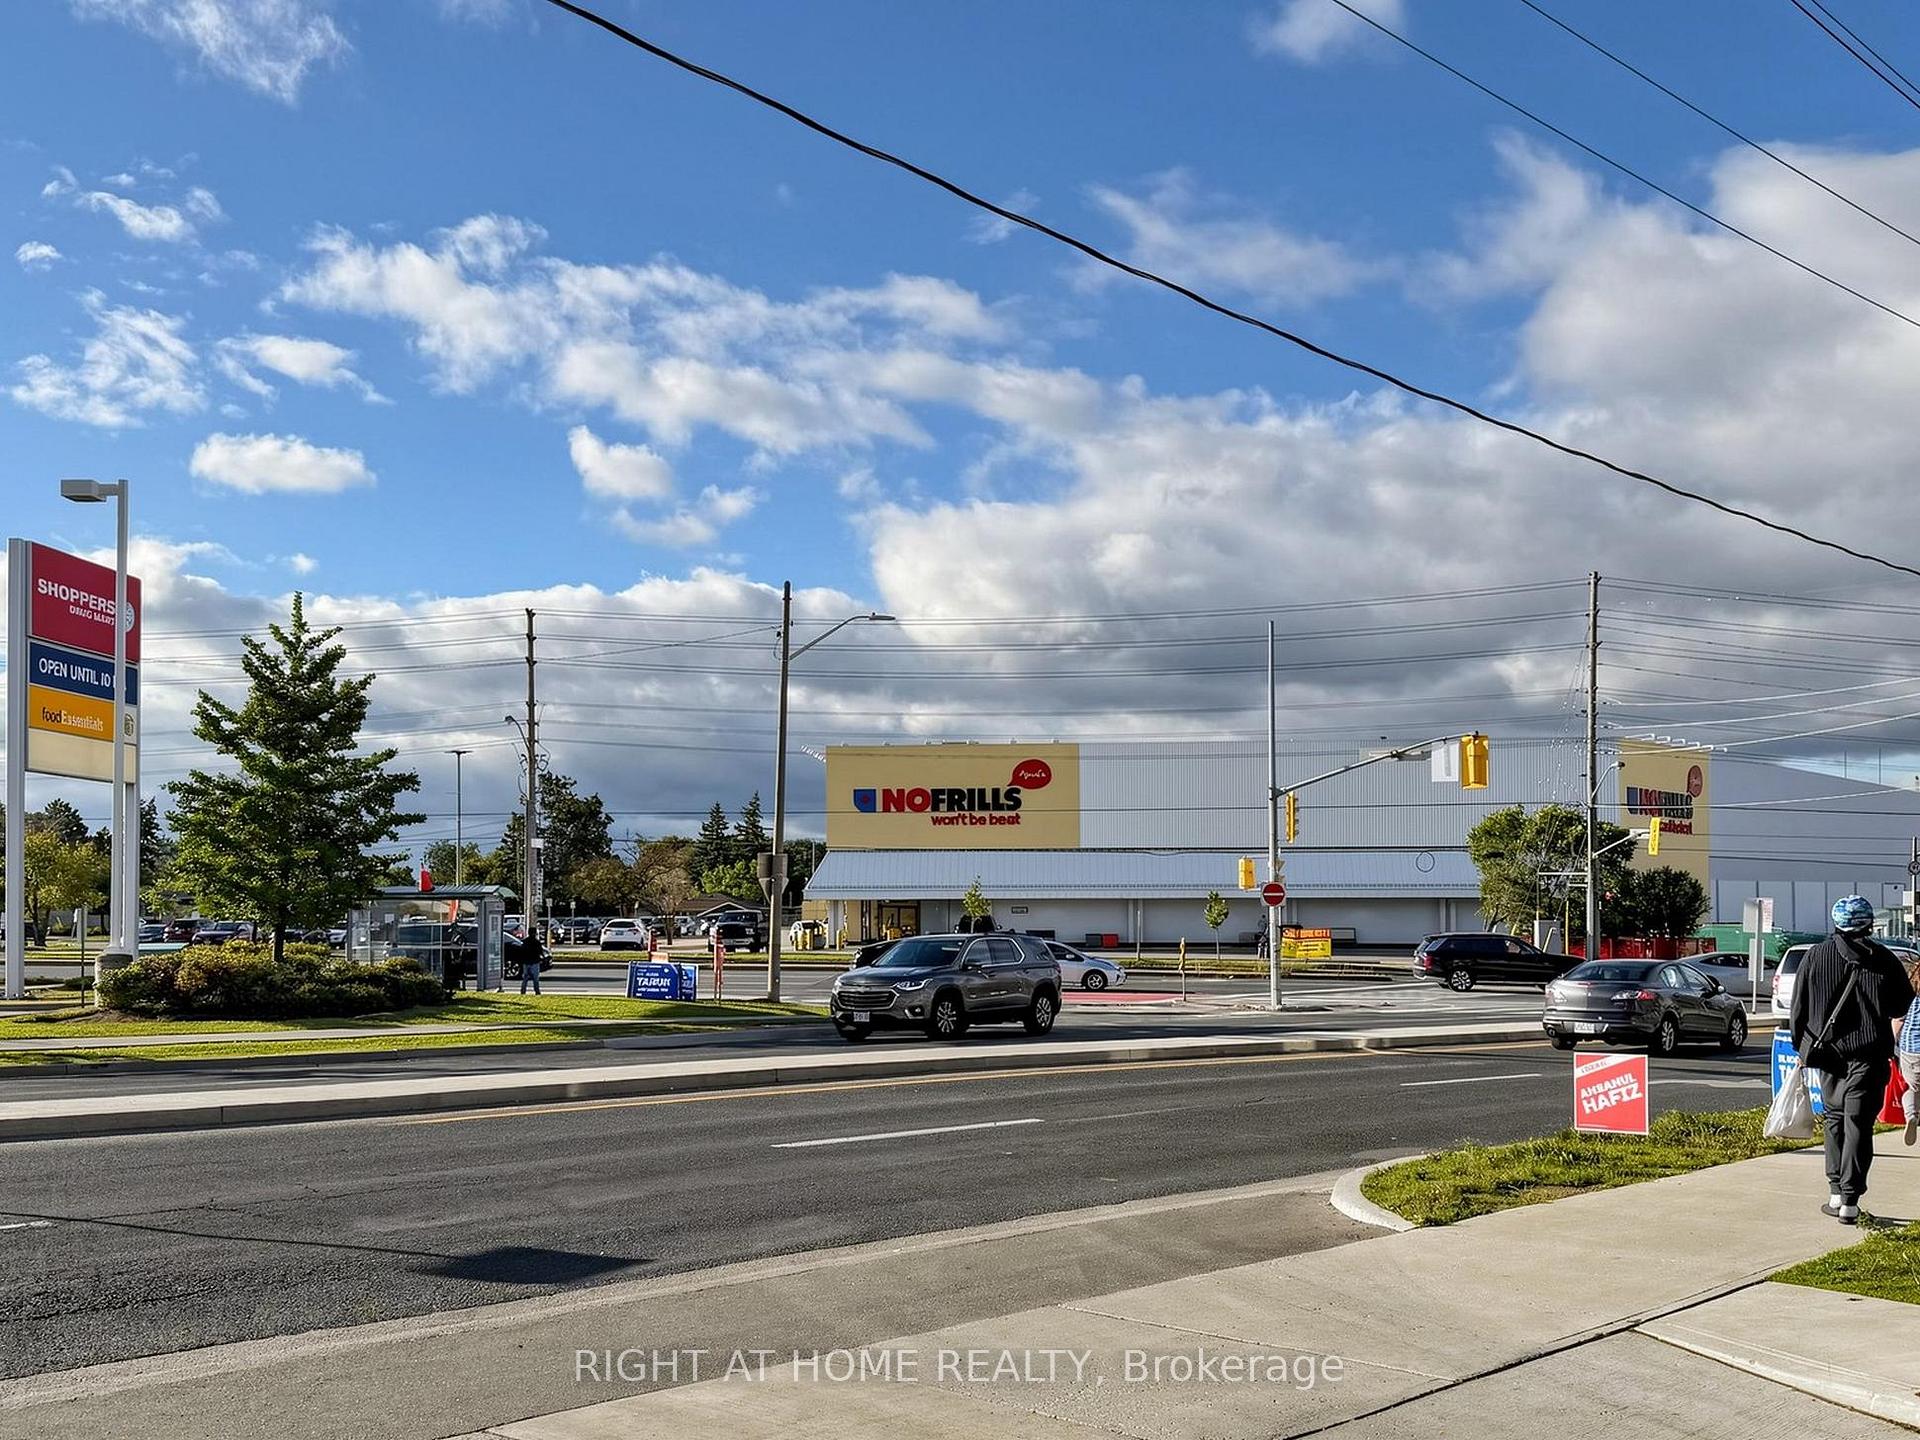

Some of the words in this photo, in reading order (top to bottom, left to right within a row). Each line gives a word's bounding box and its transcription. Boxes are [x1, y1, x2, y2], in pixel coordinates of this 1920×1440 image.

[38, 578, 116, 615] SHOPPERS
[39, 658, 67, 678] OPEN
[70, 665, 98, 685] UNTIL
[931, 814, 967, 826] won't
[969, 813, 986, 826] be
[989, 813, 1021, 826] beat
[1582, 1083, 1644, 1115] HAFIZ
